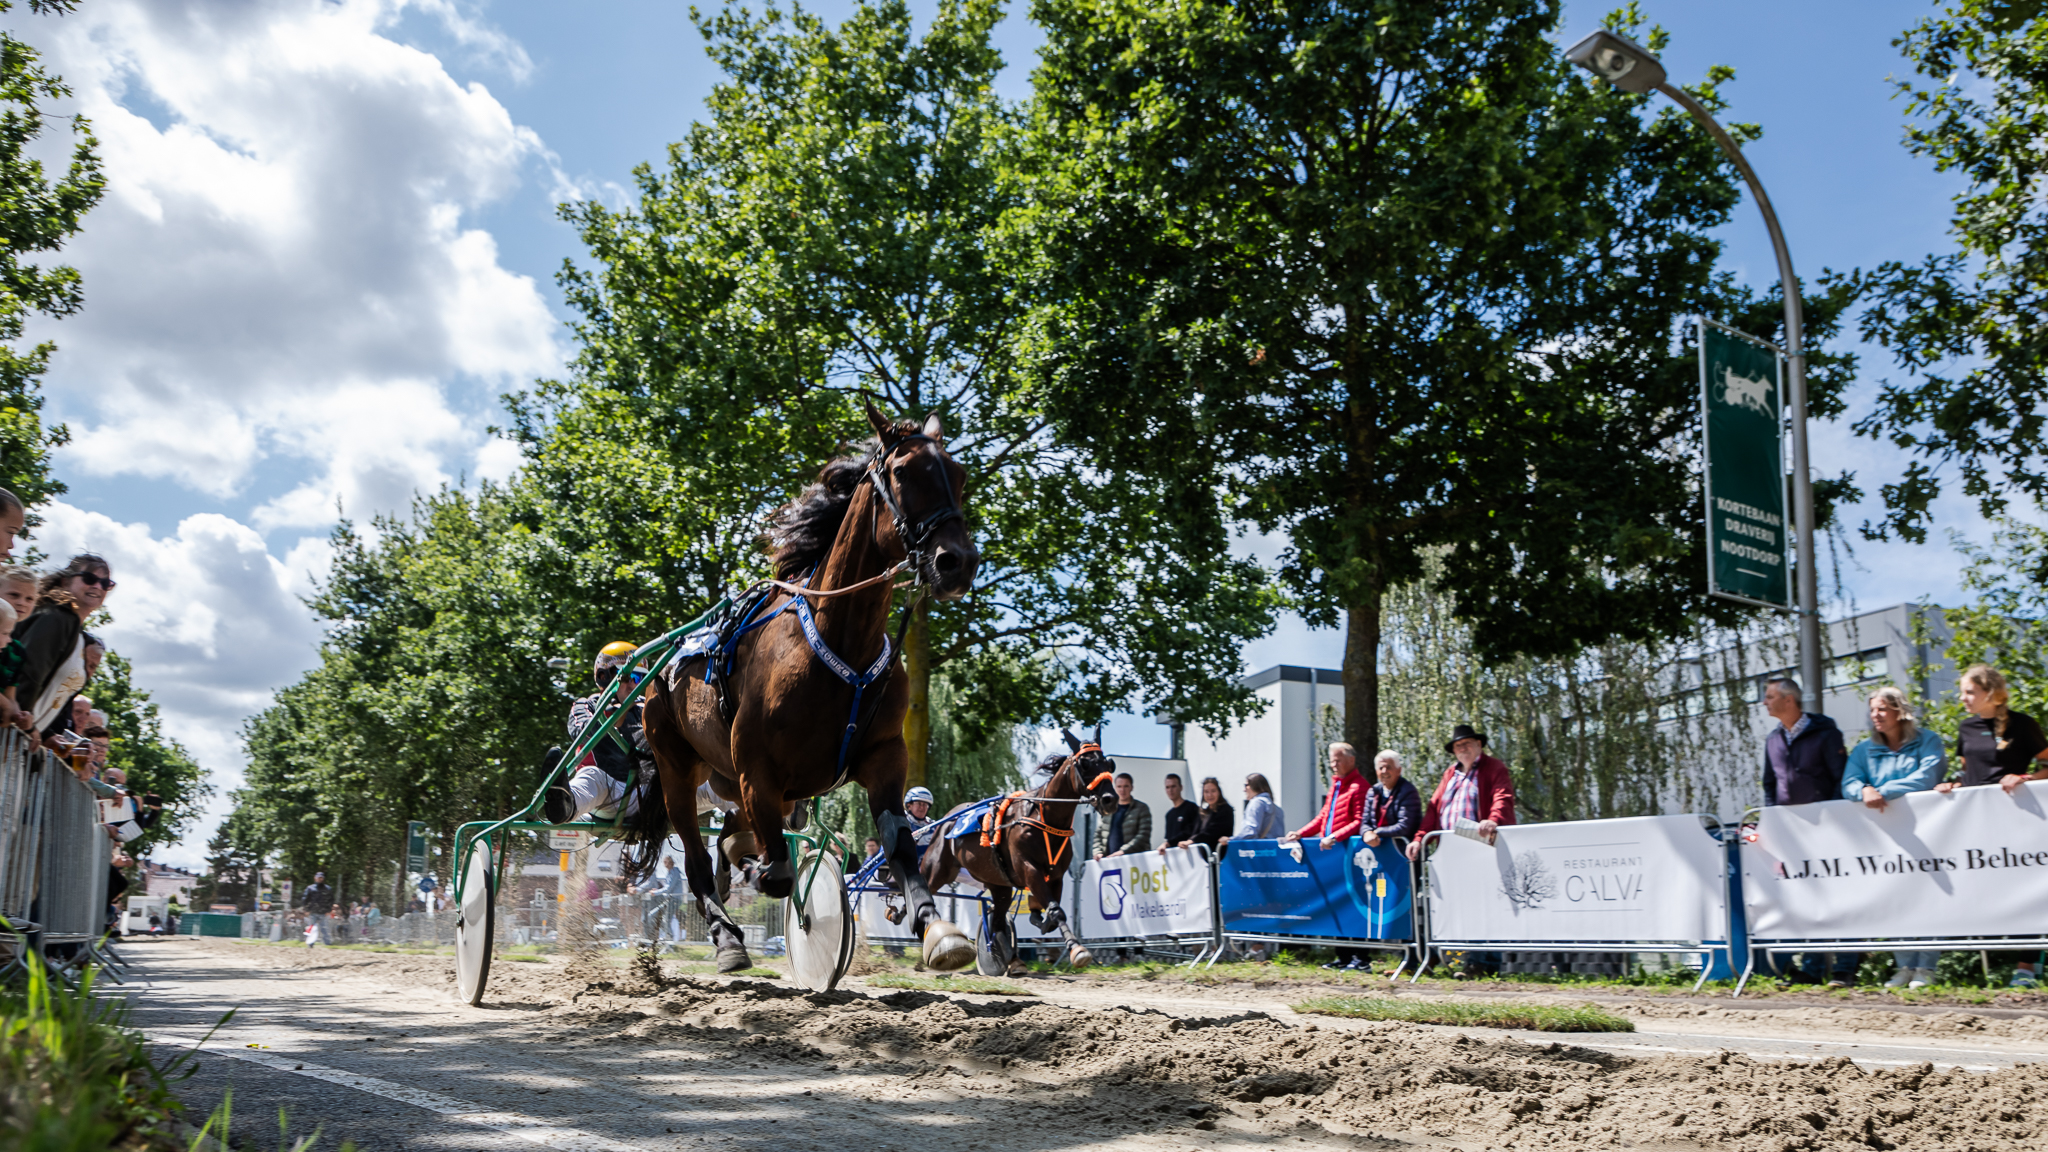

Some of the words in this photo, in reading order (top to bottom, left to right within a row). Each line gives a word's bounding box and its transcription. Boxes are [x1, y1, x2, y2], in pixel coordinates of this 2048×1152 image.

[1725, 518, 1775, 546] DRAVERIJ
[1721, 539, 1780, 566] NOOTDORP
[953, 809, 977, 835] 3
[1563, 856, 1643, 869] RESTAURANT
[1775, 857, 1850, 881] A.J.M.
[1856, 853, 1957, 876] Wolvers
[1965, 846, 2048, 870] Behee
[1130, 864, 1170, 895] Post
[1131, 899, 1187, 919] Makelaardij
